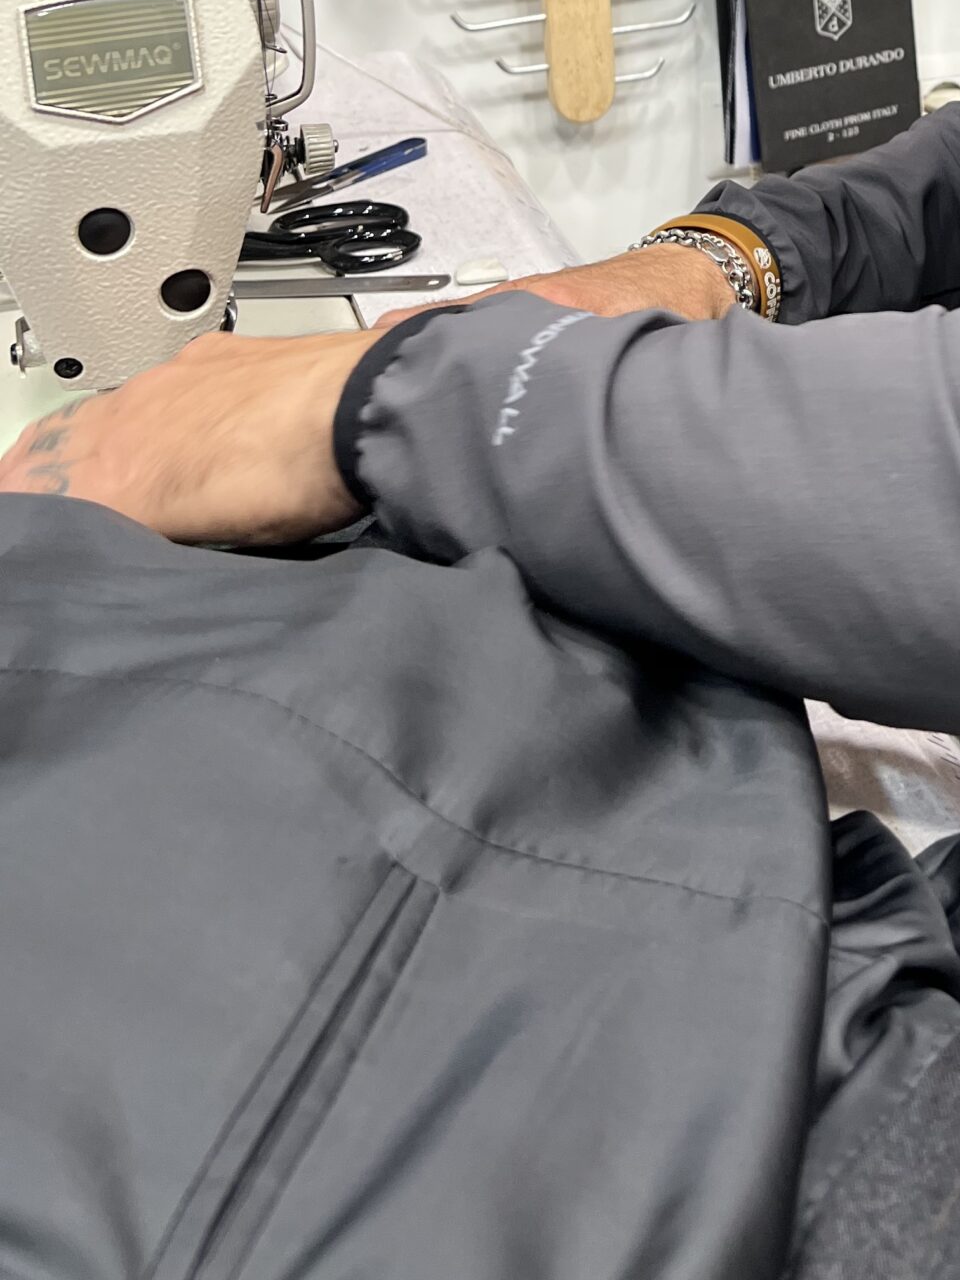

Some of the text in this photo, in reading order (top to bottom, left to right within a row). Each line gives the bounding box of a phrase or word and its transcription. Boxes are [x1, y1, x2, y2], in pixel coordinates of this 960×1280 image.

[768, 47, 905, 89] UMBERTO DURANDO
[784, 104, 899, 141] FINE CLOTH FROM ITALY
